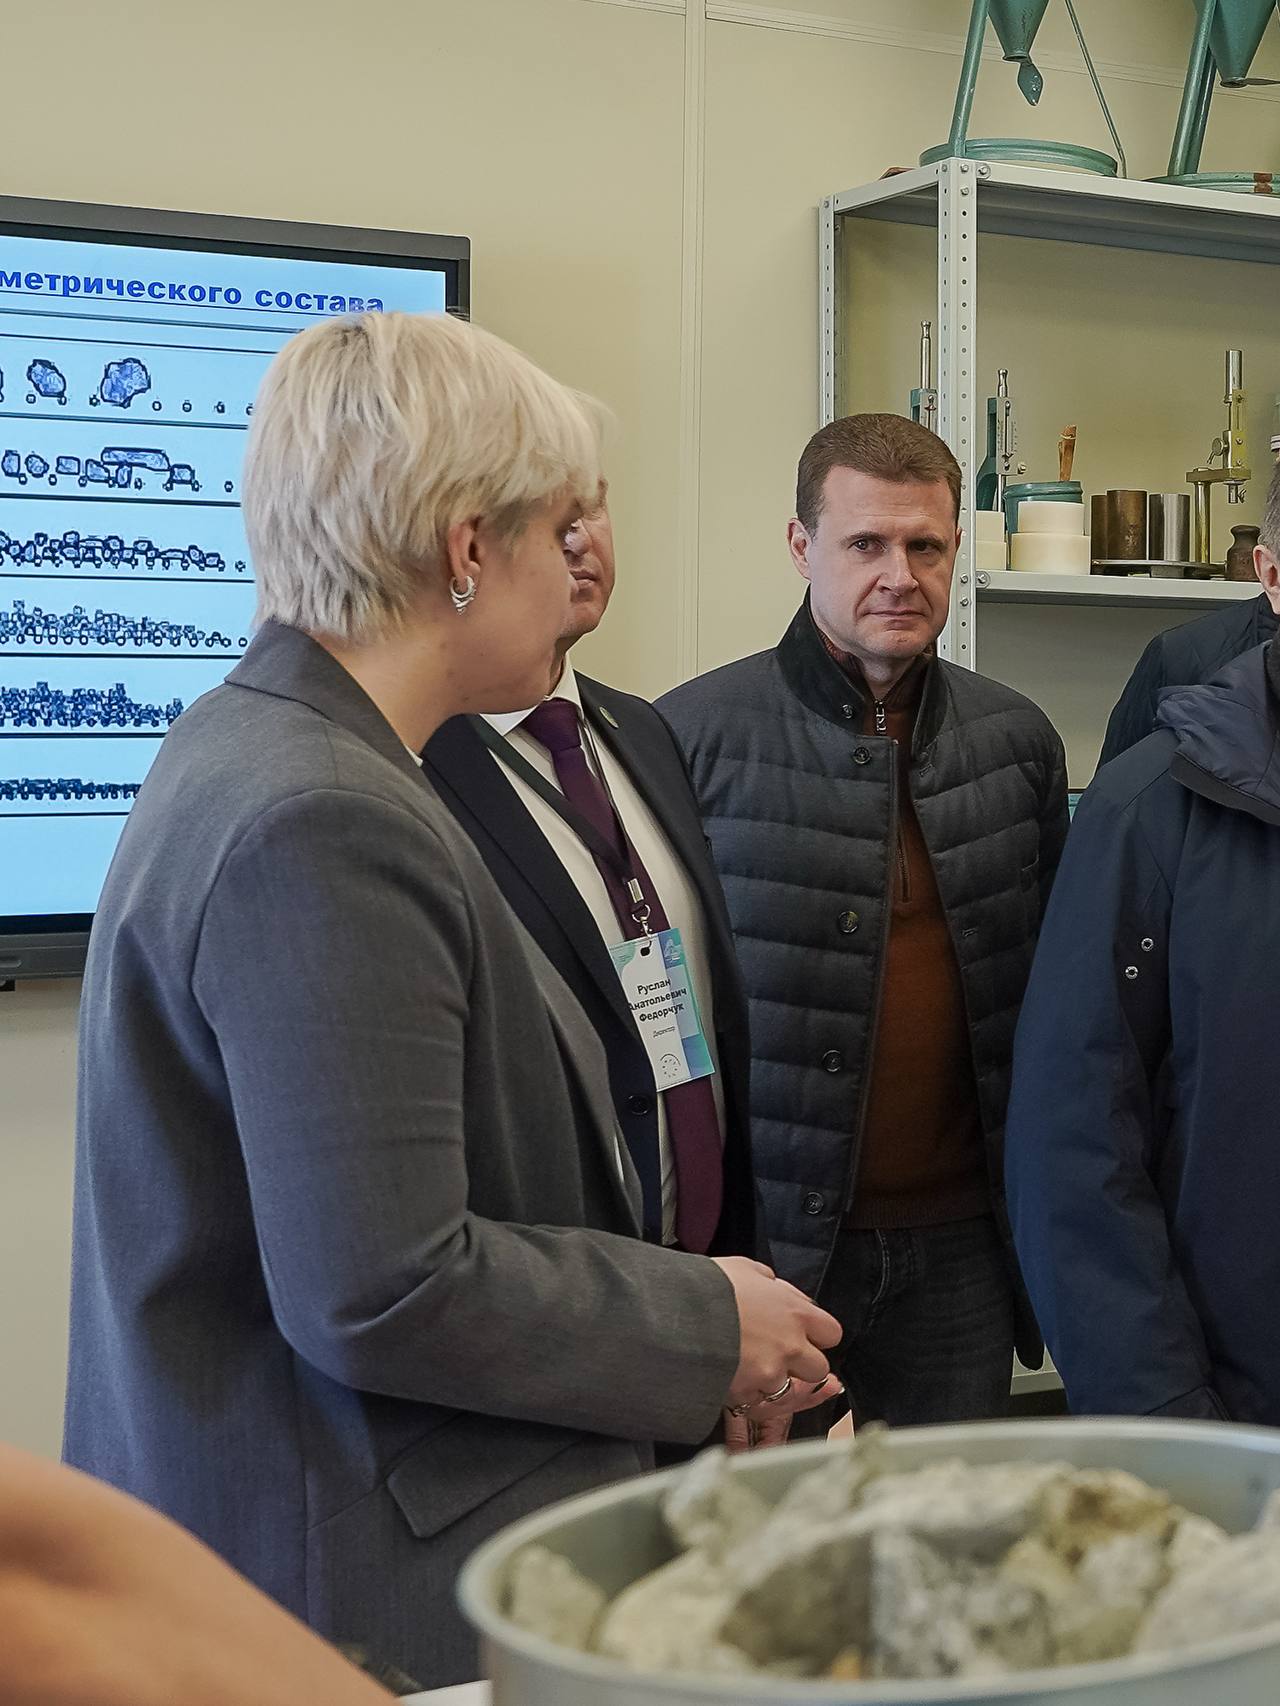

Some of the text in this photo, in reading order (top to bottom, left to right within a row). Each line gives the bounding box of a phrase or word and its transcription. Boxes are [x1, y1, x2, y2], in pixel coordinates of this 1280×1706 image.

[0, 270, 384, 314] метрического состава
[637, 978, 671, 996] Руслан
[639, 1003, 685, 1022] Федорчук
